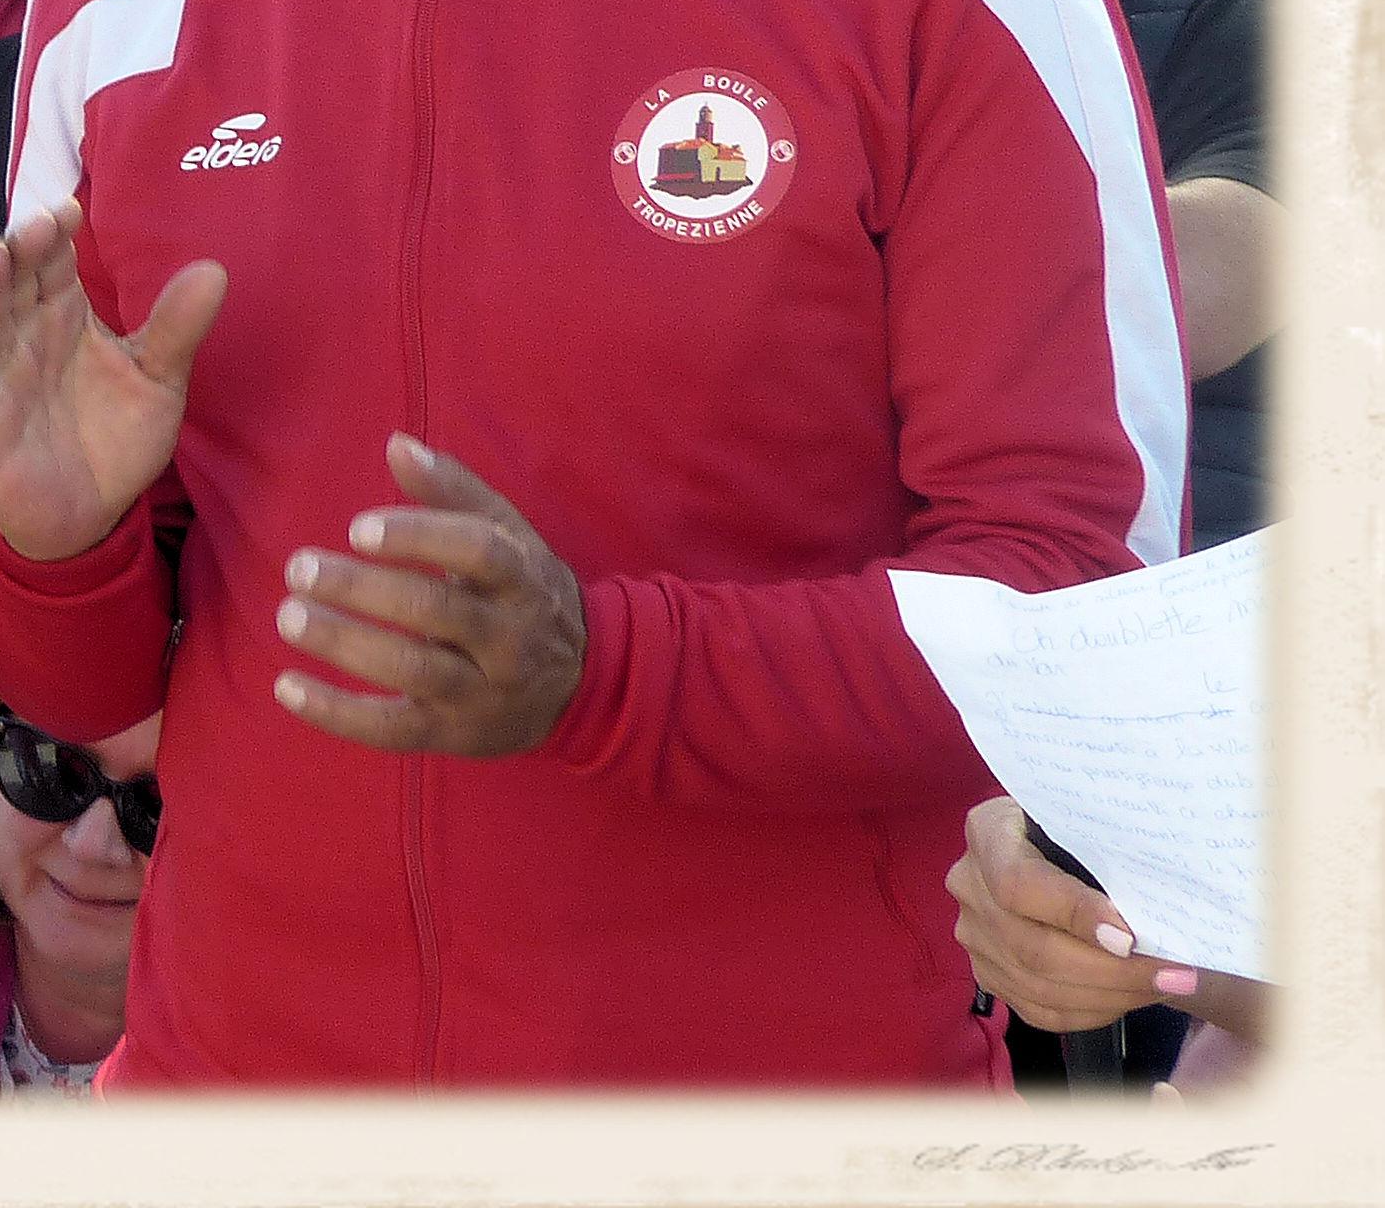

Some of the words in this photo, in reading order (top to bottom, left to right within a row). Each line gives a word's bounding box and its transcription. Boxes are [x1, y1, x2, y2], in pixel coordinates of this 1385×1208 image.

[644, 88, 671, 112] LA
[703, 74, 768, 111] BOULE
[632, 195, 764, 238] TROPEZIENNE
